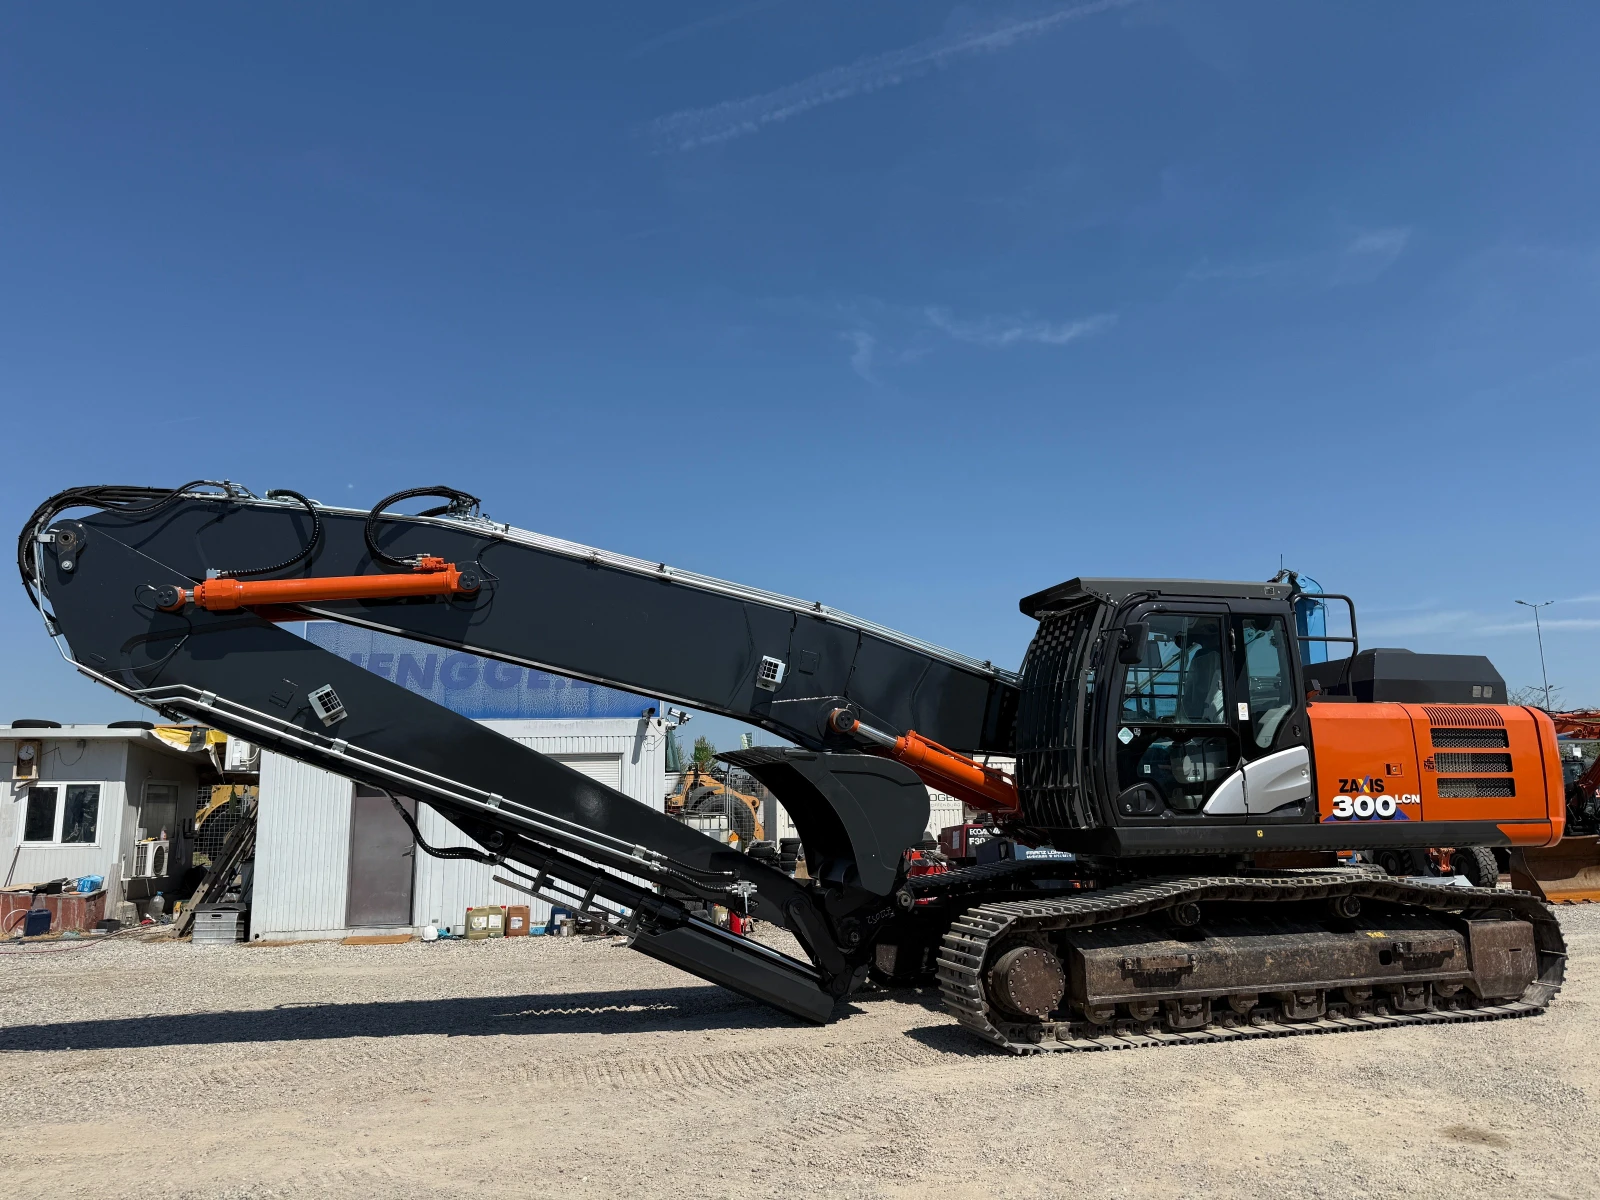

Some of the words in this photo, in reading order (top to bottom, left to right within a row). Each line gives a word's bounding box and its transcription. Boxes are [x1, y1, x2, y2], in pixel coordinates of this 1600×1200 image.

[1338, 775, 1385, 793] ZAXIS
[1332, 795, 1397, 820] 300
[1394, 794, 1420, 804] LCN
